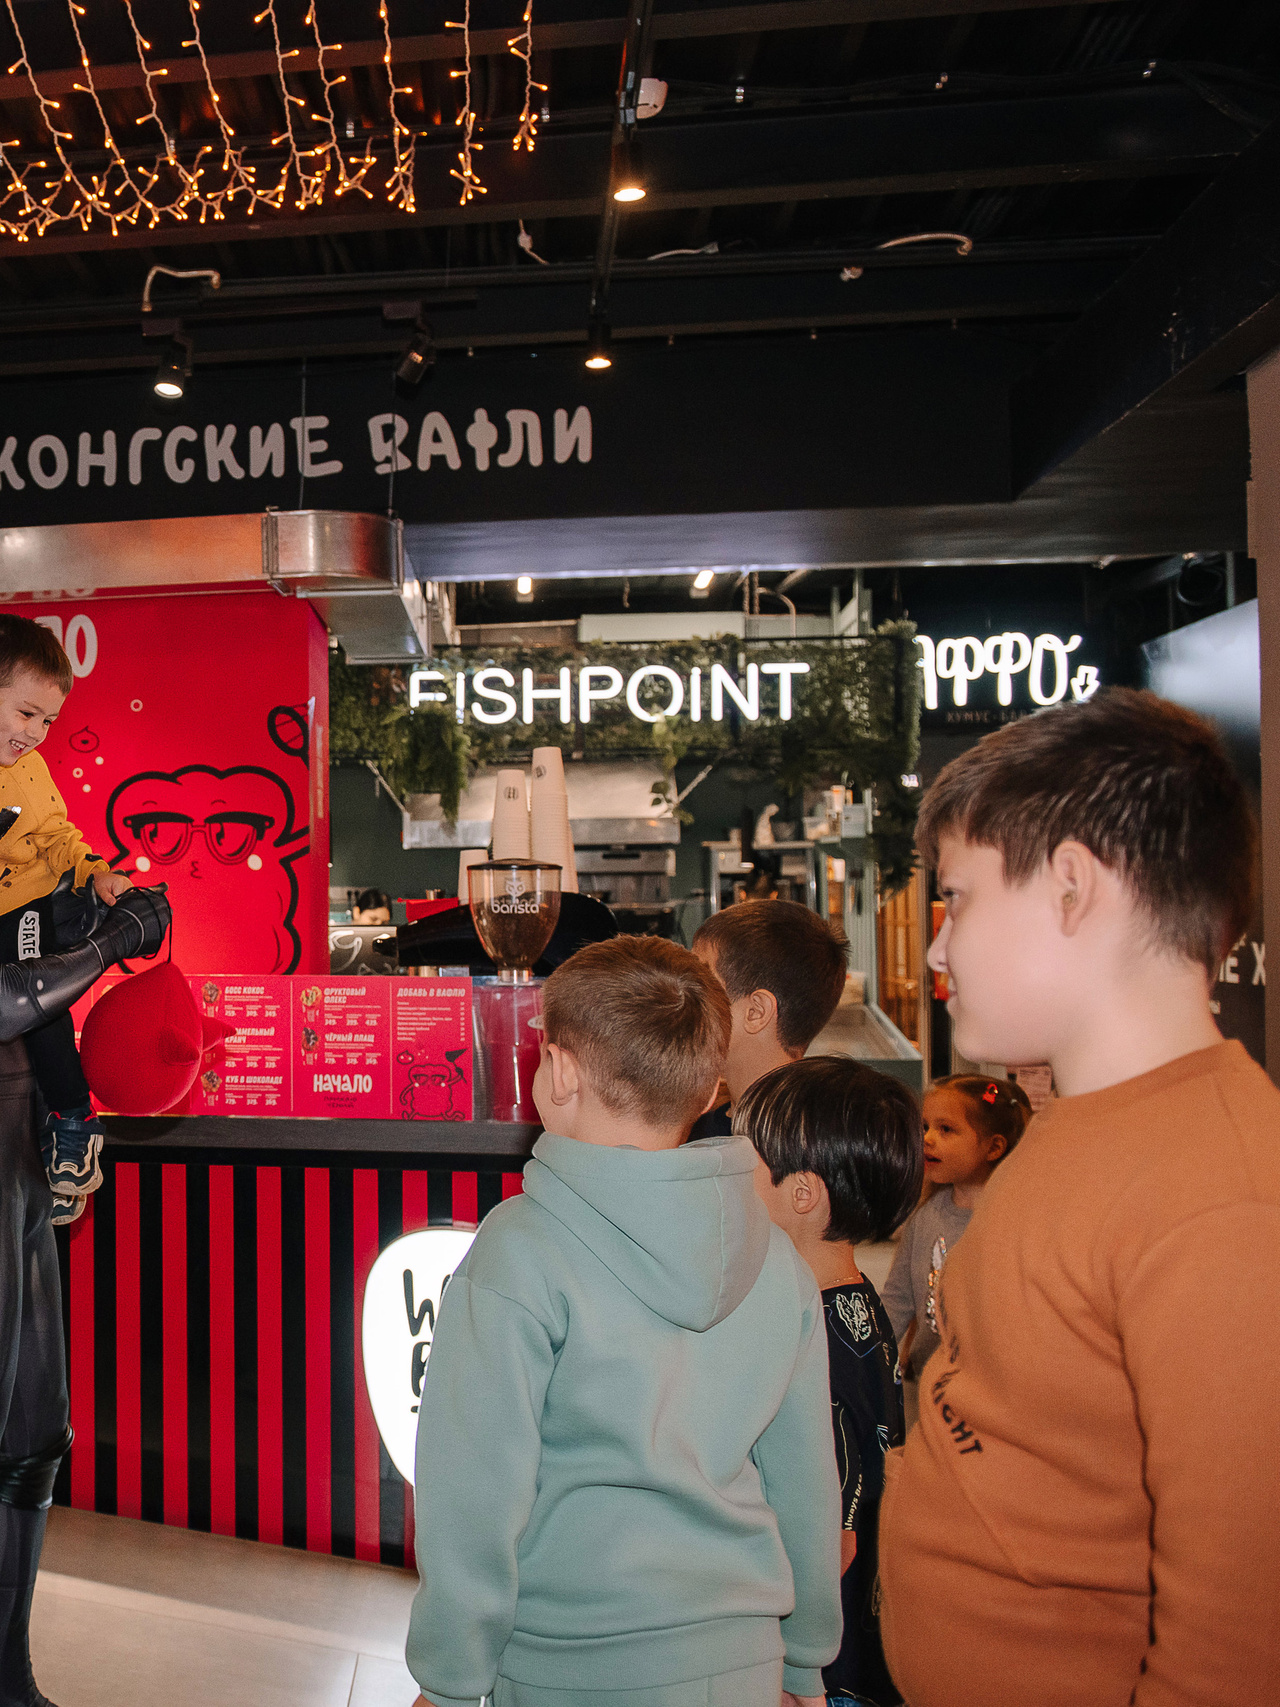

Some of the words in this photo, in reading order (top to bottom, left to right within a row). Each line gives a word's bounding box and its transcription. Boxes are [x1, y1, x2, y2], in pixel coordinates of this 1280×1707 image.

[367, 405, 592, 476] ВАФЛИ
[491, 902, 539, 914] barista
[22, 916, 36, 955] STATE
[225, 986, 242, 994] БОСС
[243, 986, 265, 994] КОКОС
[324, 986, 366, 996] ФРУКТОВЫЙ
[397, 988, 427, 997] ДОБАВЬ
[429, 988, 435, 997] В
[436, 988, 466, 997] ВАФЛЮ
[324, 995, 347, 1004] ФЛЕКС
[324, 1032, 353, 1042] ЧЁРНЫЙ
[225, 1075, 239, 1084] КУБ
[245, 1075, 283, 1085] ШОКОЛАДЕ
